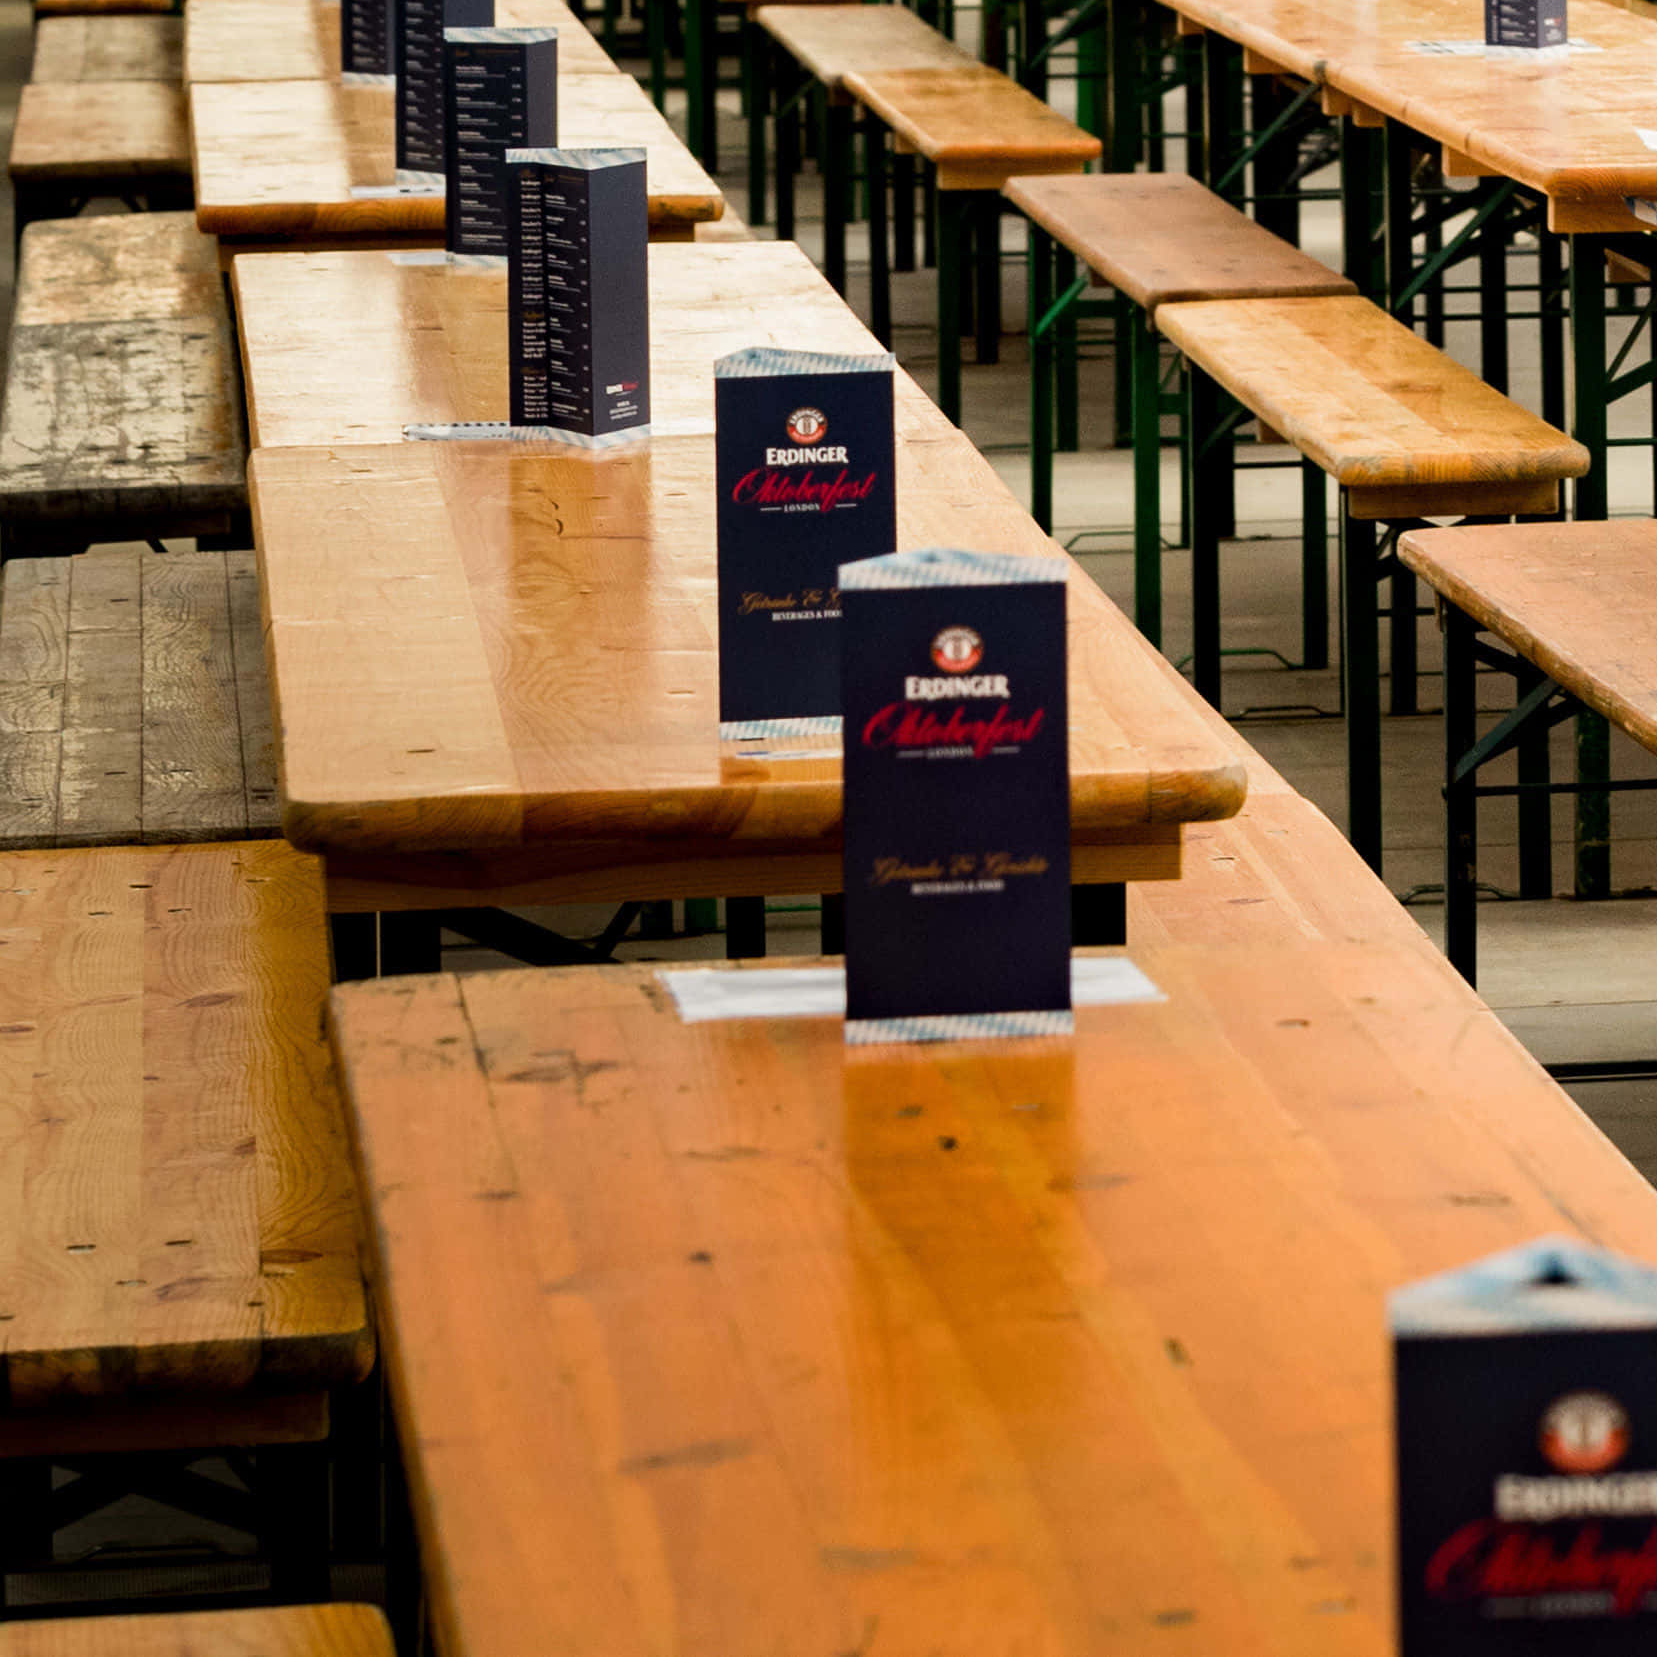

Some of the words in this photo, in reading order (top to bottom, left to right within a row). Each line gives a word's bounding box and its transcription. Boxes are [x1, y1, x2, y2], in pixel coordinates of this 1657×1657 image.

[765, 446, 850, 466] ERDINGER
[732, 467, 876, 513] Oktoberfest
[783, 503, 821, 514] LONDON
[824, 609, 842, 619] FOO
[905, 674, 1011, 702] ERDINGER
